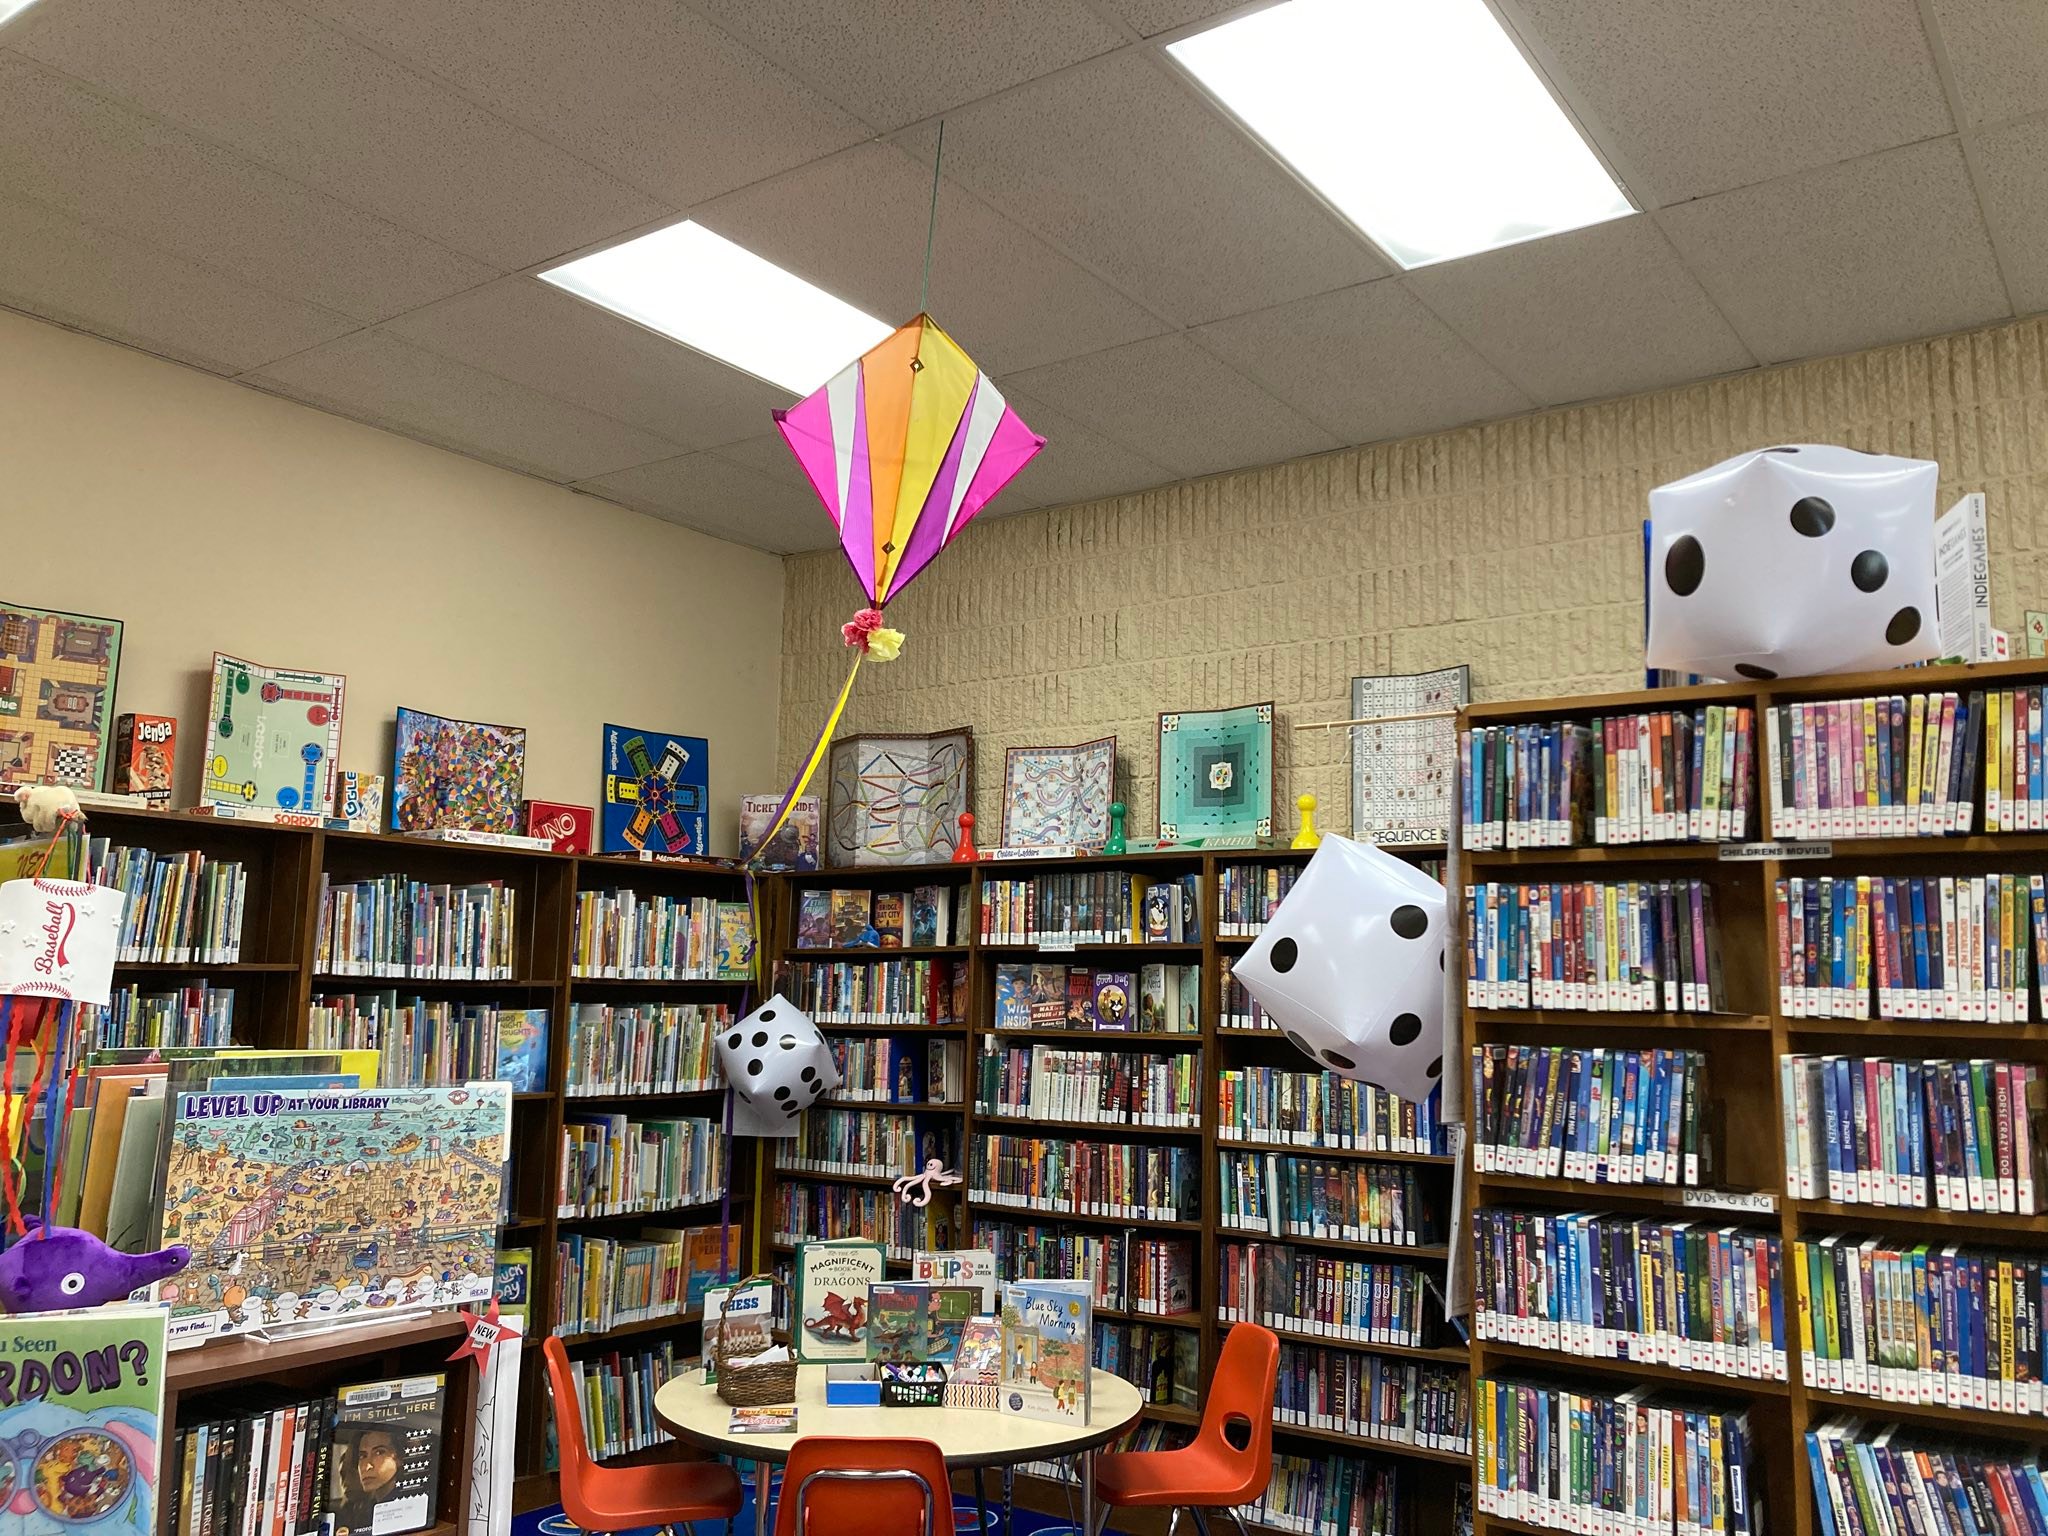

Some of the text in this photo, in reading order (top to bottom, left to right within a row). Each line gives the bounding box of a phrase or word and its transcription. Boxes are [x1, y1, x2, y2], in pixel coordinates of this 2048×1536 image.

[1972, 527, 1988, 608] INDIEGAMES
[138, 720, 172, 742] Jenga
[253, 716, 266, 768] SORRY!
[609, 729, 619, 771] Aggravation
[746, 801, 780, 813] TICKET
[274, 814, 319, 828] SORRY!
[533, 812, 576, 844] UNO
[1200, 836, 1253, 848] KIMBO
[1372, 829, 1437, 844] SEQUENCE
[1721, 846, 1830, 857] CHILDRENS MOVIES
[34, 900, 65, 975] Baseball
[1807, 944, 1817, 973] COCO
[1003, 1016, 1031, 1028] INSID
[1131, 1075, 1140, 1089] TWO
[1591, 1086, 1601, 1101] elf
[186, 1094, 390, 1119] LEVEL UP AT YOUR LIBRARY
[1329, 1089, 1338, 1129] CITY SPIES
[1342, 1090, 1351, 1130] CITY SPIES
[1554, 1092, 1565, 1125] DUMBO
[1611, 1096, 1622, 1119] epic
[1567, 1120, 1577, 1136] MAN
[1826, 1109, 1837, 1144] FROZEN
[1842, 1120, 1850, 1145] FROZEN
[1998, 1087, 2010, 1176] HORSE CRAZY TOO
[1030, 1164, 1038, 1185] WINK
[1685, 1191, 1769, 1208] DVDs G & PG
[810, 1257, 876, 1273] MAGNIFICENT
[1065, 1237, 1073, 1272] CONSTABLE
[919, 1260, 974, 1280] BLIPS
[814, 1277, 871, 1287] DRAGONS
[719, 1297, 759, 1312] CHESS
[1025, 1296, 1064, 1318] Blue Sky
[474, 1324, 497, 1340] NEW
[1039, 1313, 1076, 1335] Morning
[13, 1337, 57, 1352] Seen
[2002, 1316, 2013, 1364] BATMAN
[1334, 1359, 1345, 1383] BIG
[344, 1412, 361, 1423] I'M
[367, 1408, 399, 1419] STILL
[406, 1401, 436, 1413] HERE
[1518, 1407, 1527, 1454] MADELINE
[287, 1463, 301, 1525] SATURDAY NIGHT
[311, 1446, 328, 1520] SPEAK EVIL
[1638, 1471, 1646, 1498] SCHOOL
[202, 1503, 213, 1536] FORGE
